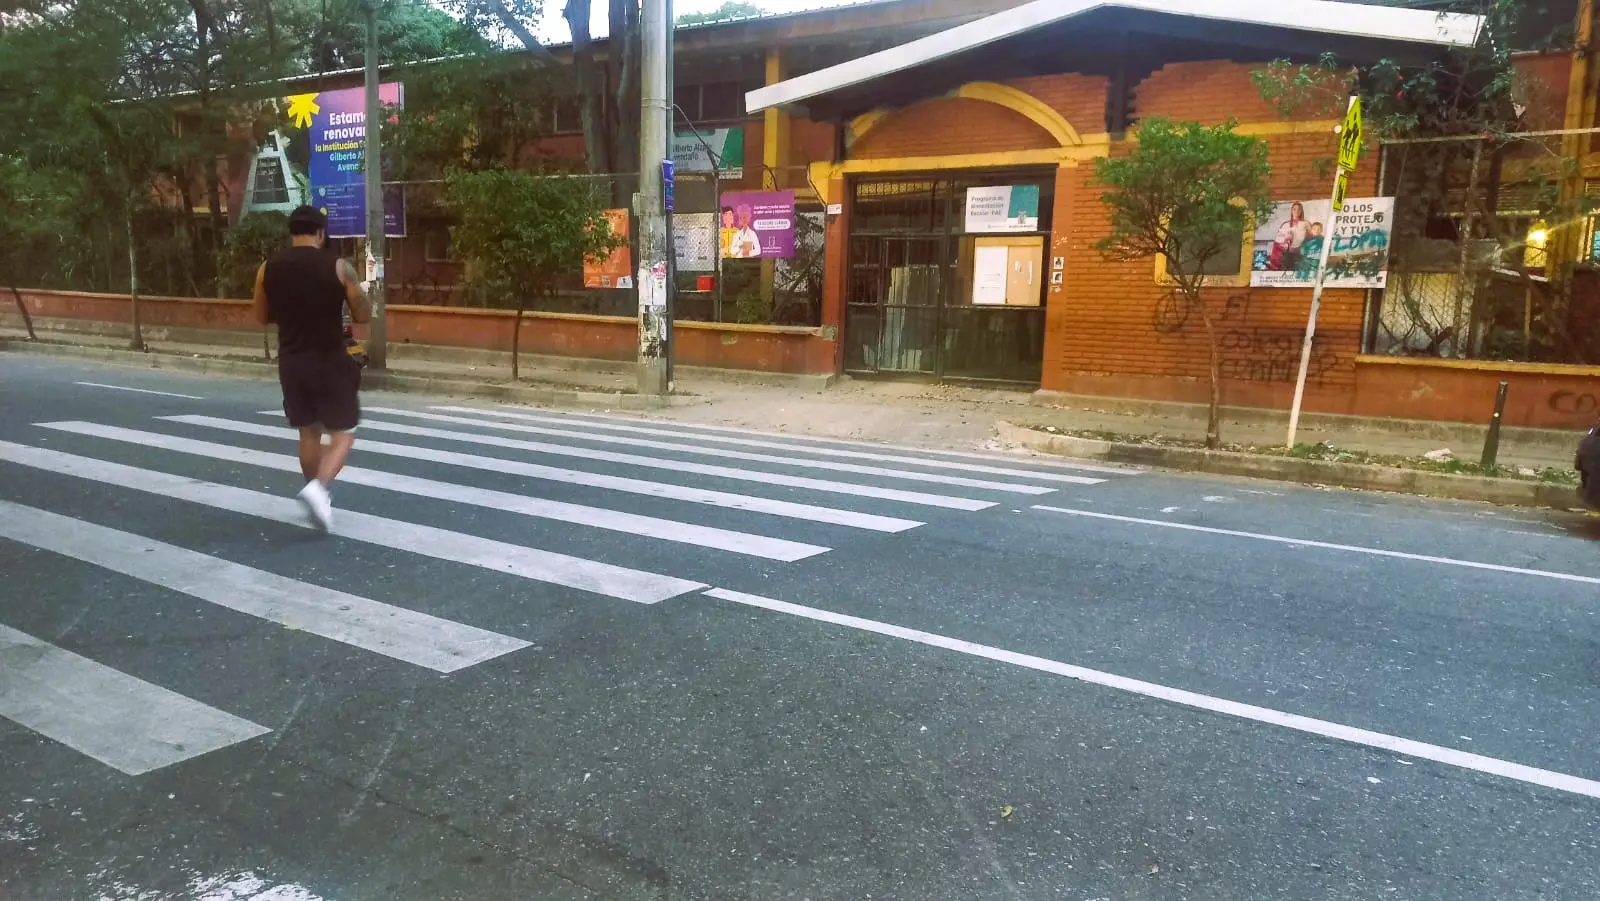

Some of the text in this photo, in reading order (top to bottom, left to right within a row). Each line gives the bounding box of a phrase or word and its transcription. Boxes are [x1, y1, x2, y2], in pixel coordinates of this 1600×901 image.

[673, 143, 692, 152] ilberto
[329, 152, 357, 161] Gilberto
[673, 151, 699, 161] vendaño
[1353, 204, 1373, 213] LOS
